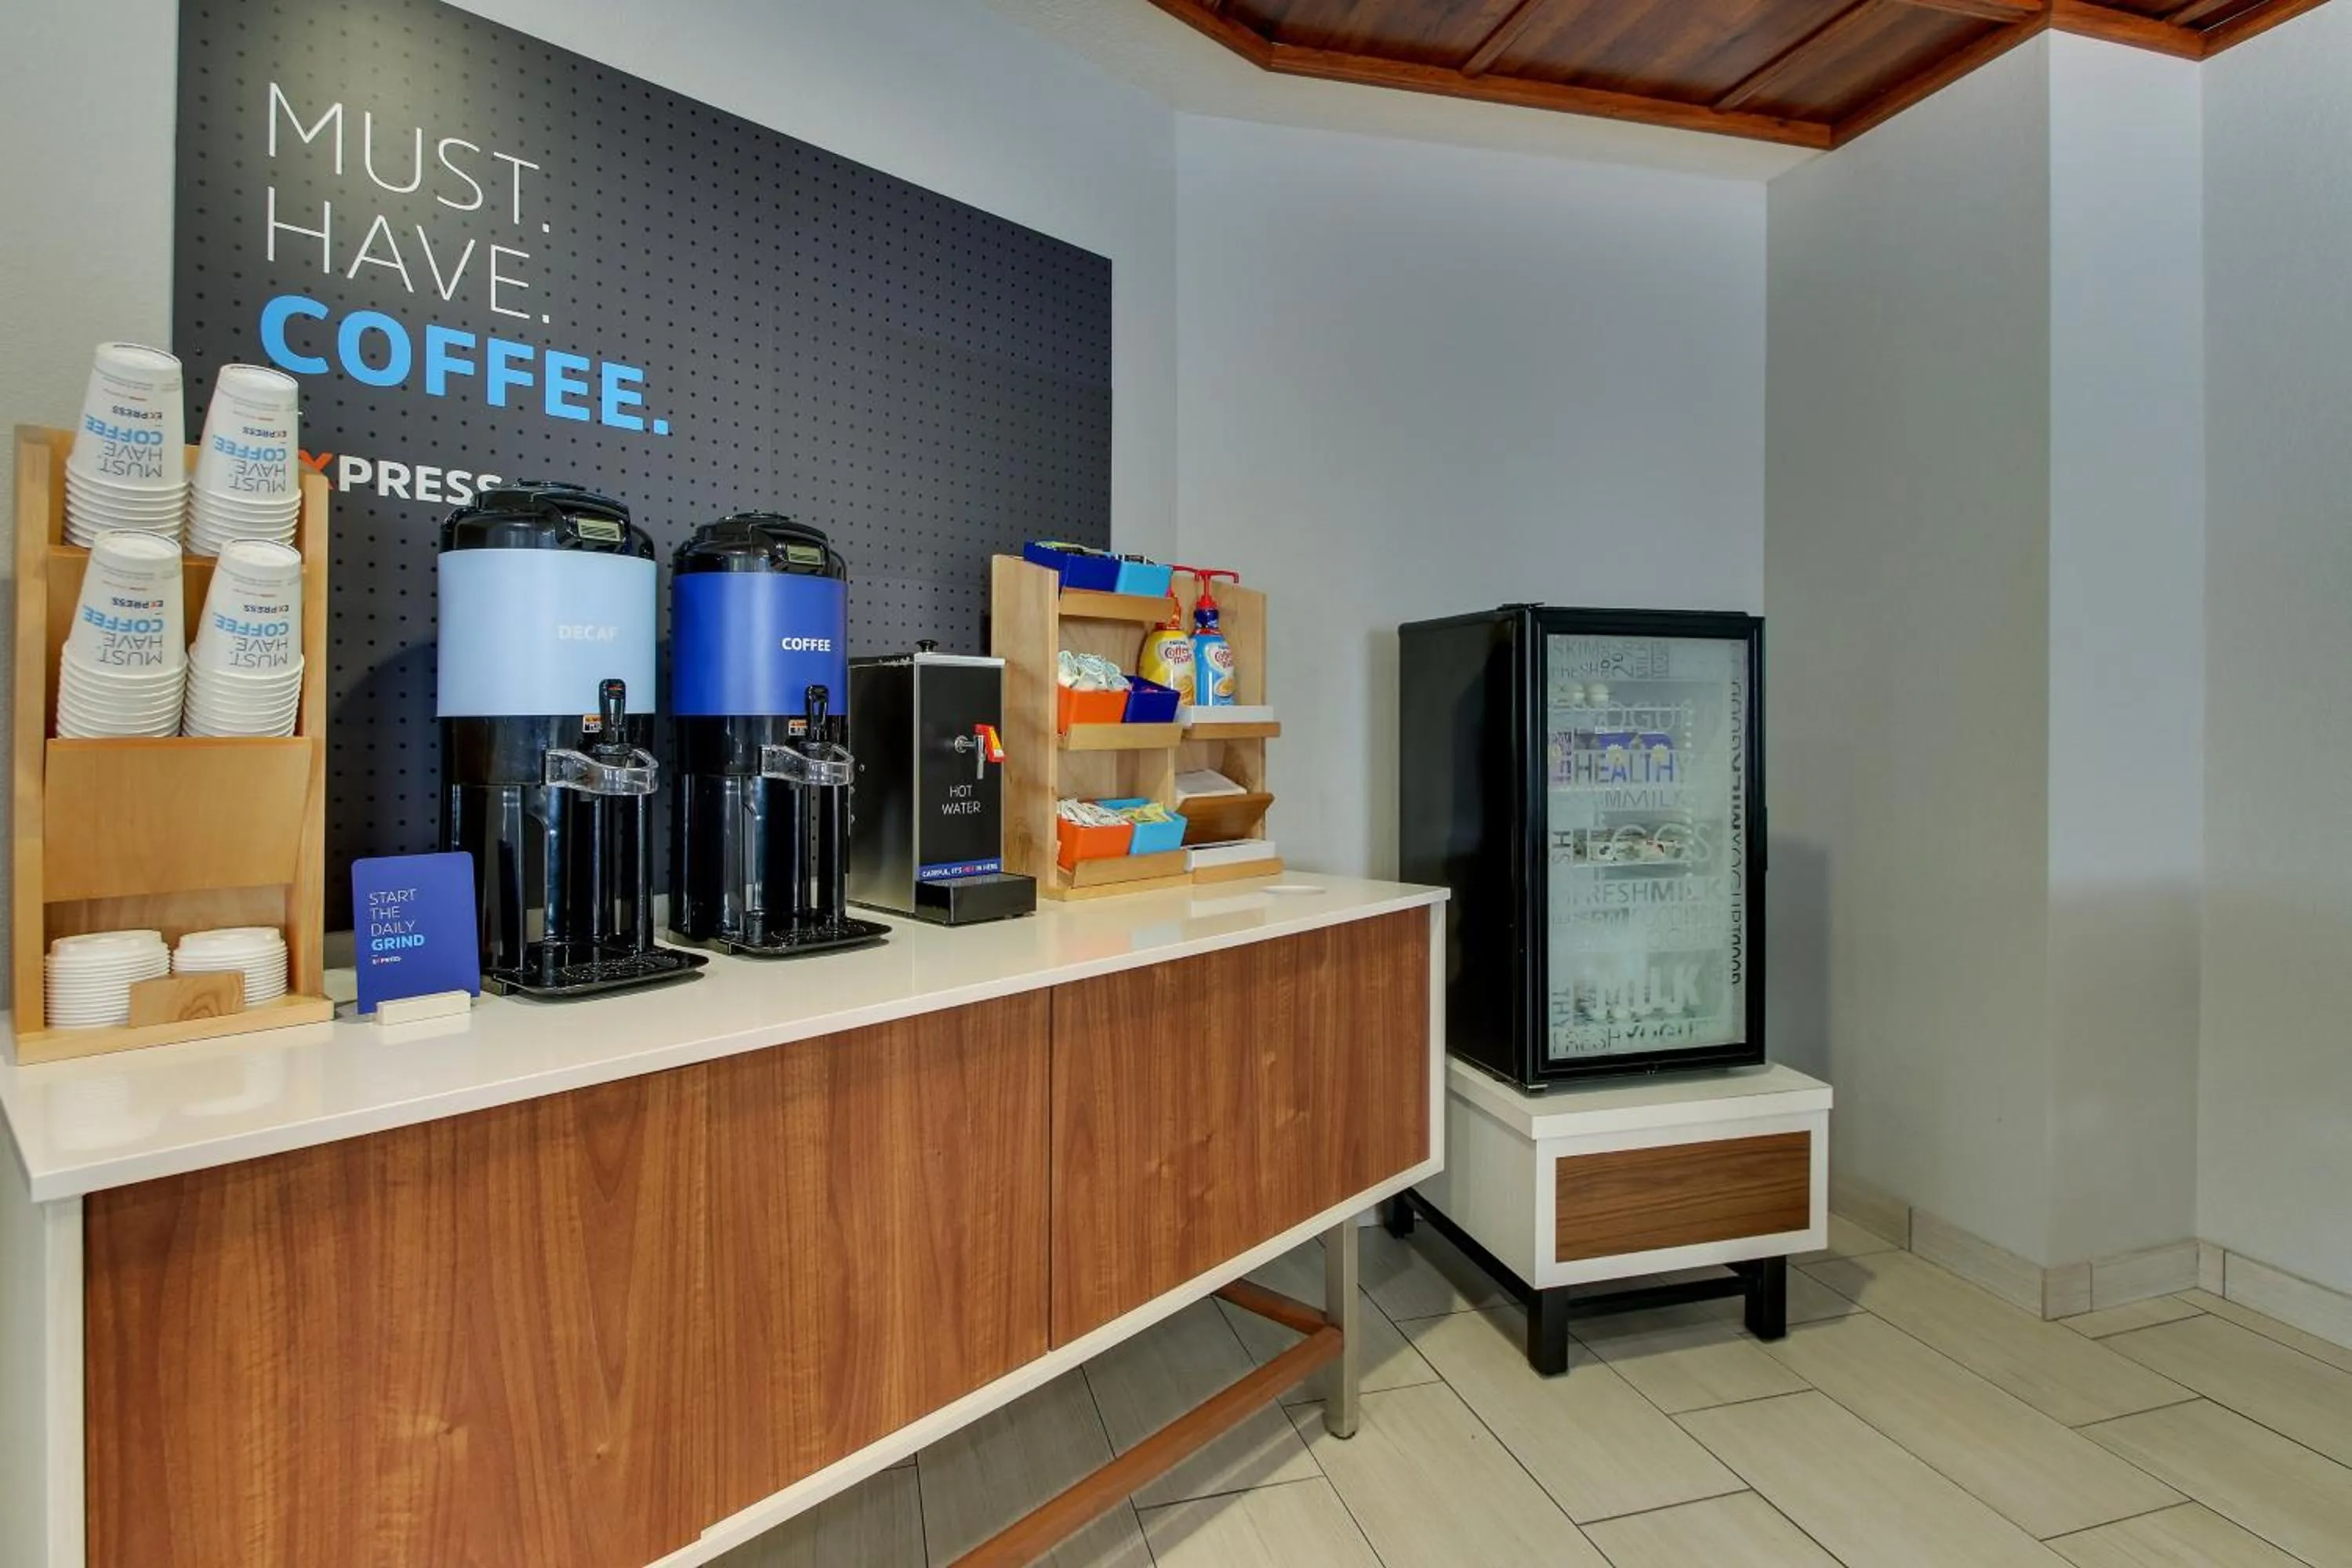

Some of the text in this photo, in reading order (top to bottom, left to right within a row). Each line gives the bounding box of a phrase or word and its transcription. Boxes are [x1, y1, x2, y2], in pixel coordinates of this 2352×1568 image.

[268, 81, 550, 233] MUST.
[267, 185, 550, 324] HAVE.
[260, 293, 670, 435] COFFEE.
[298, 448, 503, 506] XPRES
[557, 624, 619, 643] DECAF
[782, 637, 831, 652] COFFEE
[949, 785, 973, 798] HOT
[942, 800, 982, 816] WATER
[369, 888, 417, 905] START
[370, 906, 401, 920] THE
[371, 920, 416, 937] DAILY
[371, 935, 426, 951] GRIND
